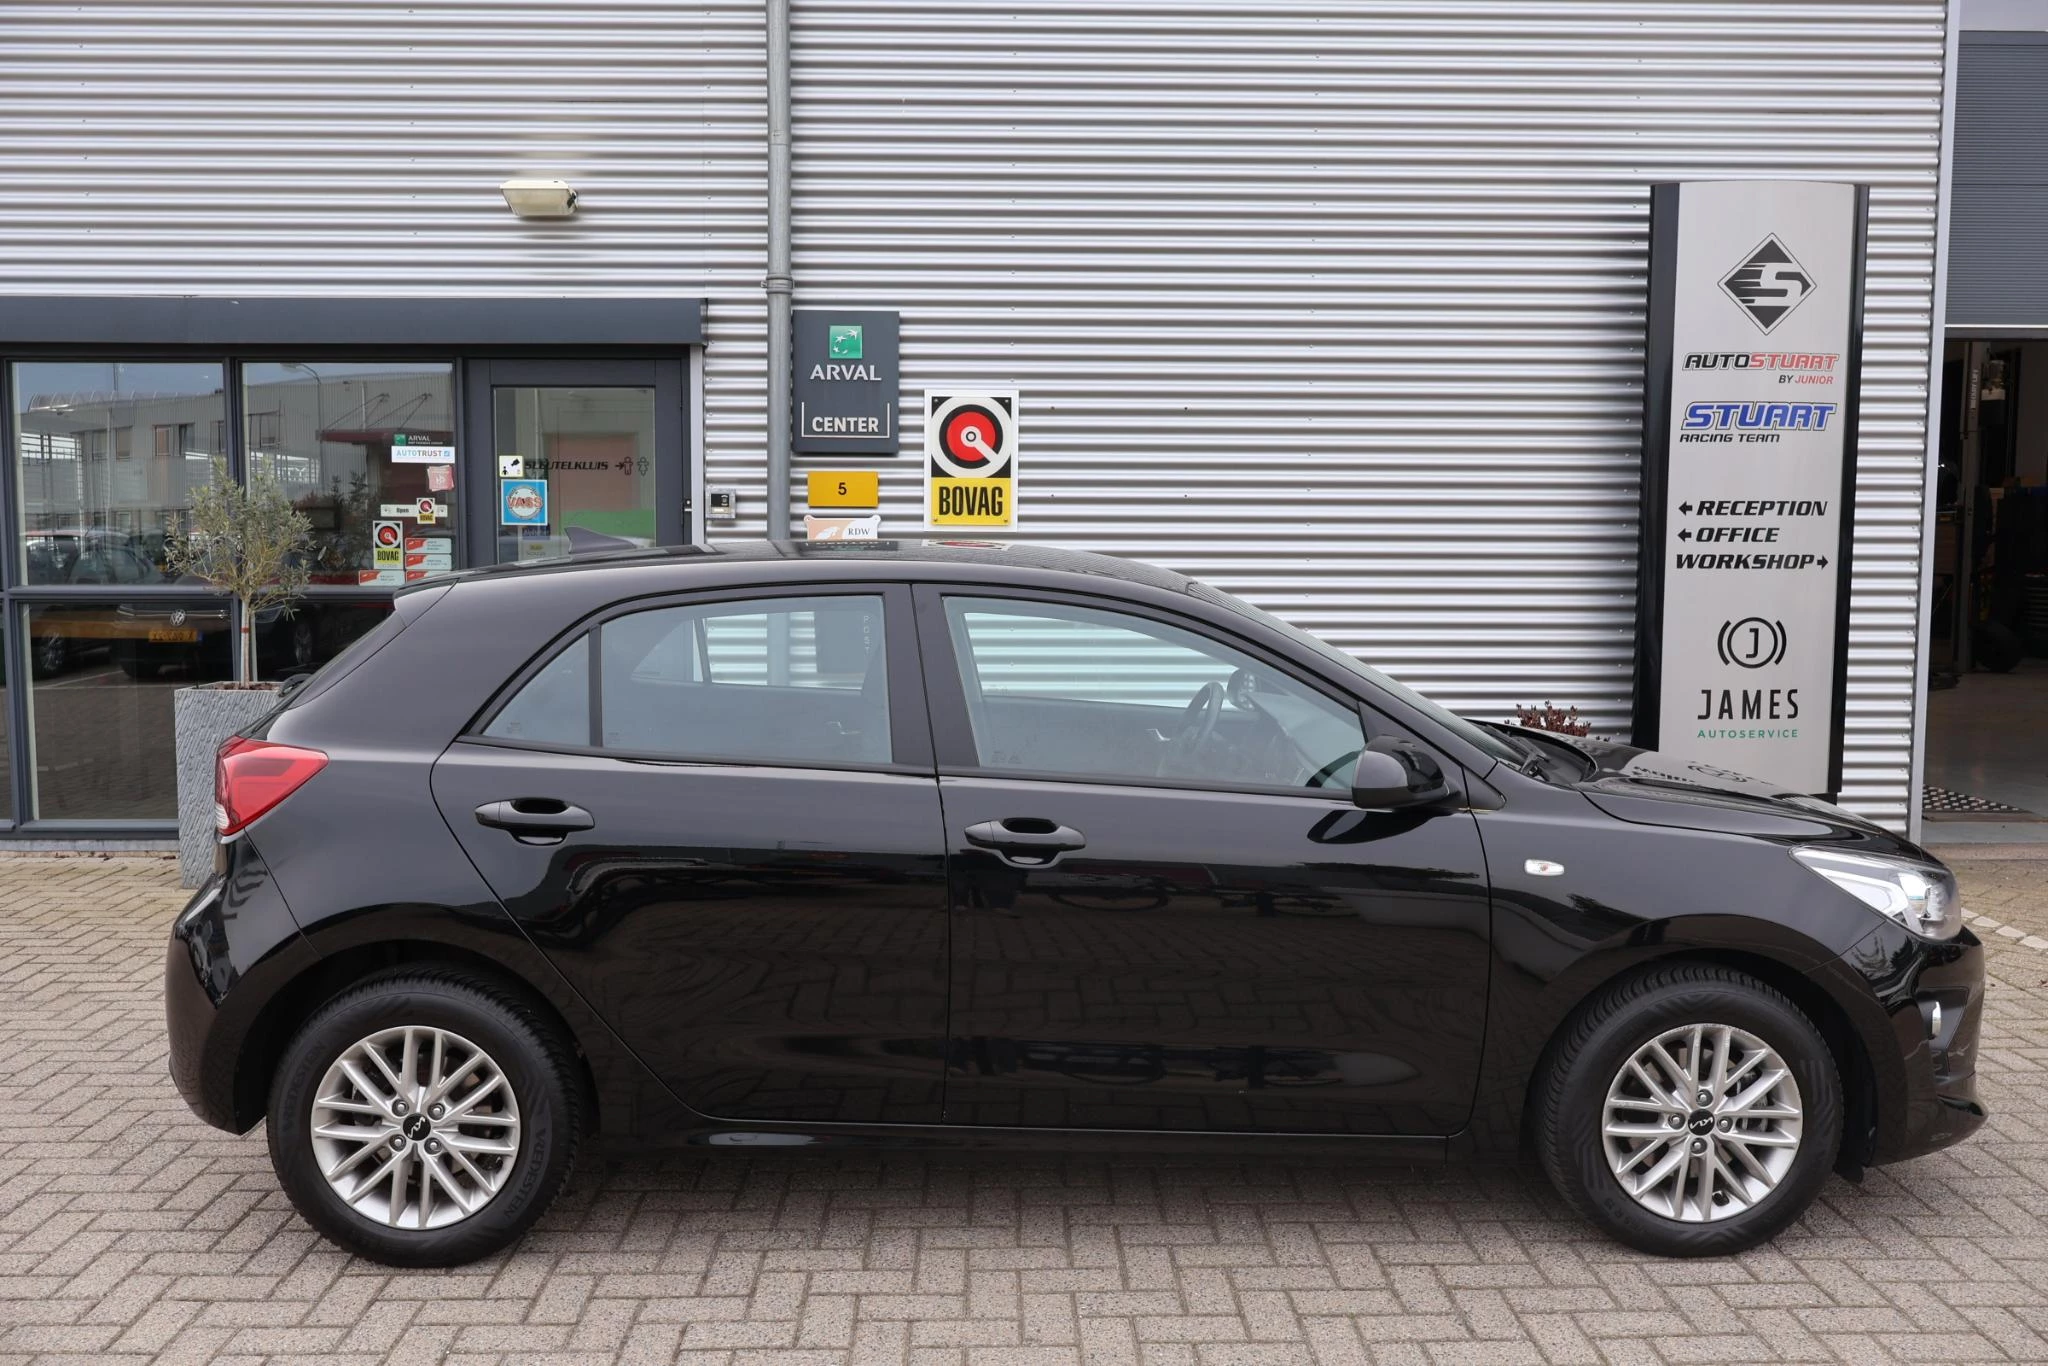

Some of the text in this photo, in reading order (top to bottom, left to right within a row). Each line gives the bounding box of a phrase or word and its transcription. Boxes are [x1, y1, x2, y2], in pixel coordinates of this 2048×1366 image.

[809, 364, 882, 381] ARVAL
[1778, 374, 1833, 385] BY JUNIOR
[1681, 401, 1838, 431] STUART
[811, 416, 879, 433] CENTER
[1679, 433, 1780, 443] RACING TEAM
[396, 449, 442, 457] AUTOTRUST
[837, 482, 847, 495] 5
[938, 485, 1004, 517] BOVAG
[1696, 500, 1828, 516] RECEPTION
[848, 527, 870, 536] RDW
[1696, 527, 1780, 543] OFFICE
[377, 550, 399, 561] BOVAG
[1676, 554, 1815, 569] WORKSHOP
[1745, 627, 1760, 659] J
[1697, 689, 1799, 720] JAMES
[1697, 729, 1798, 738] AUTOSERVICE
